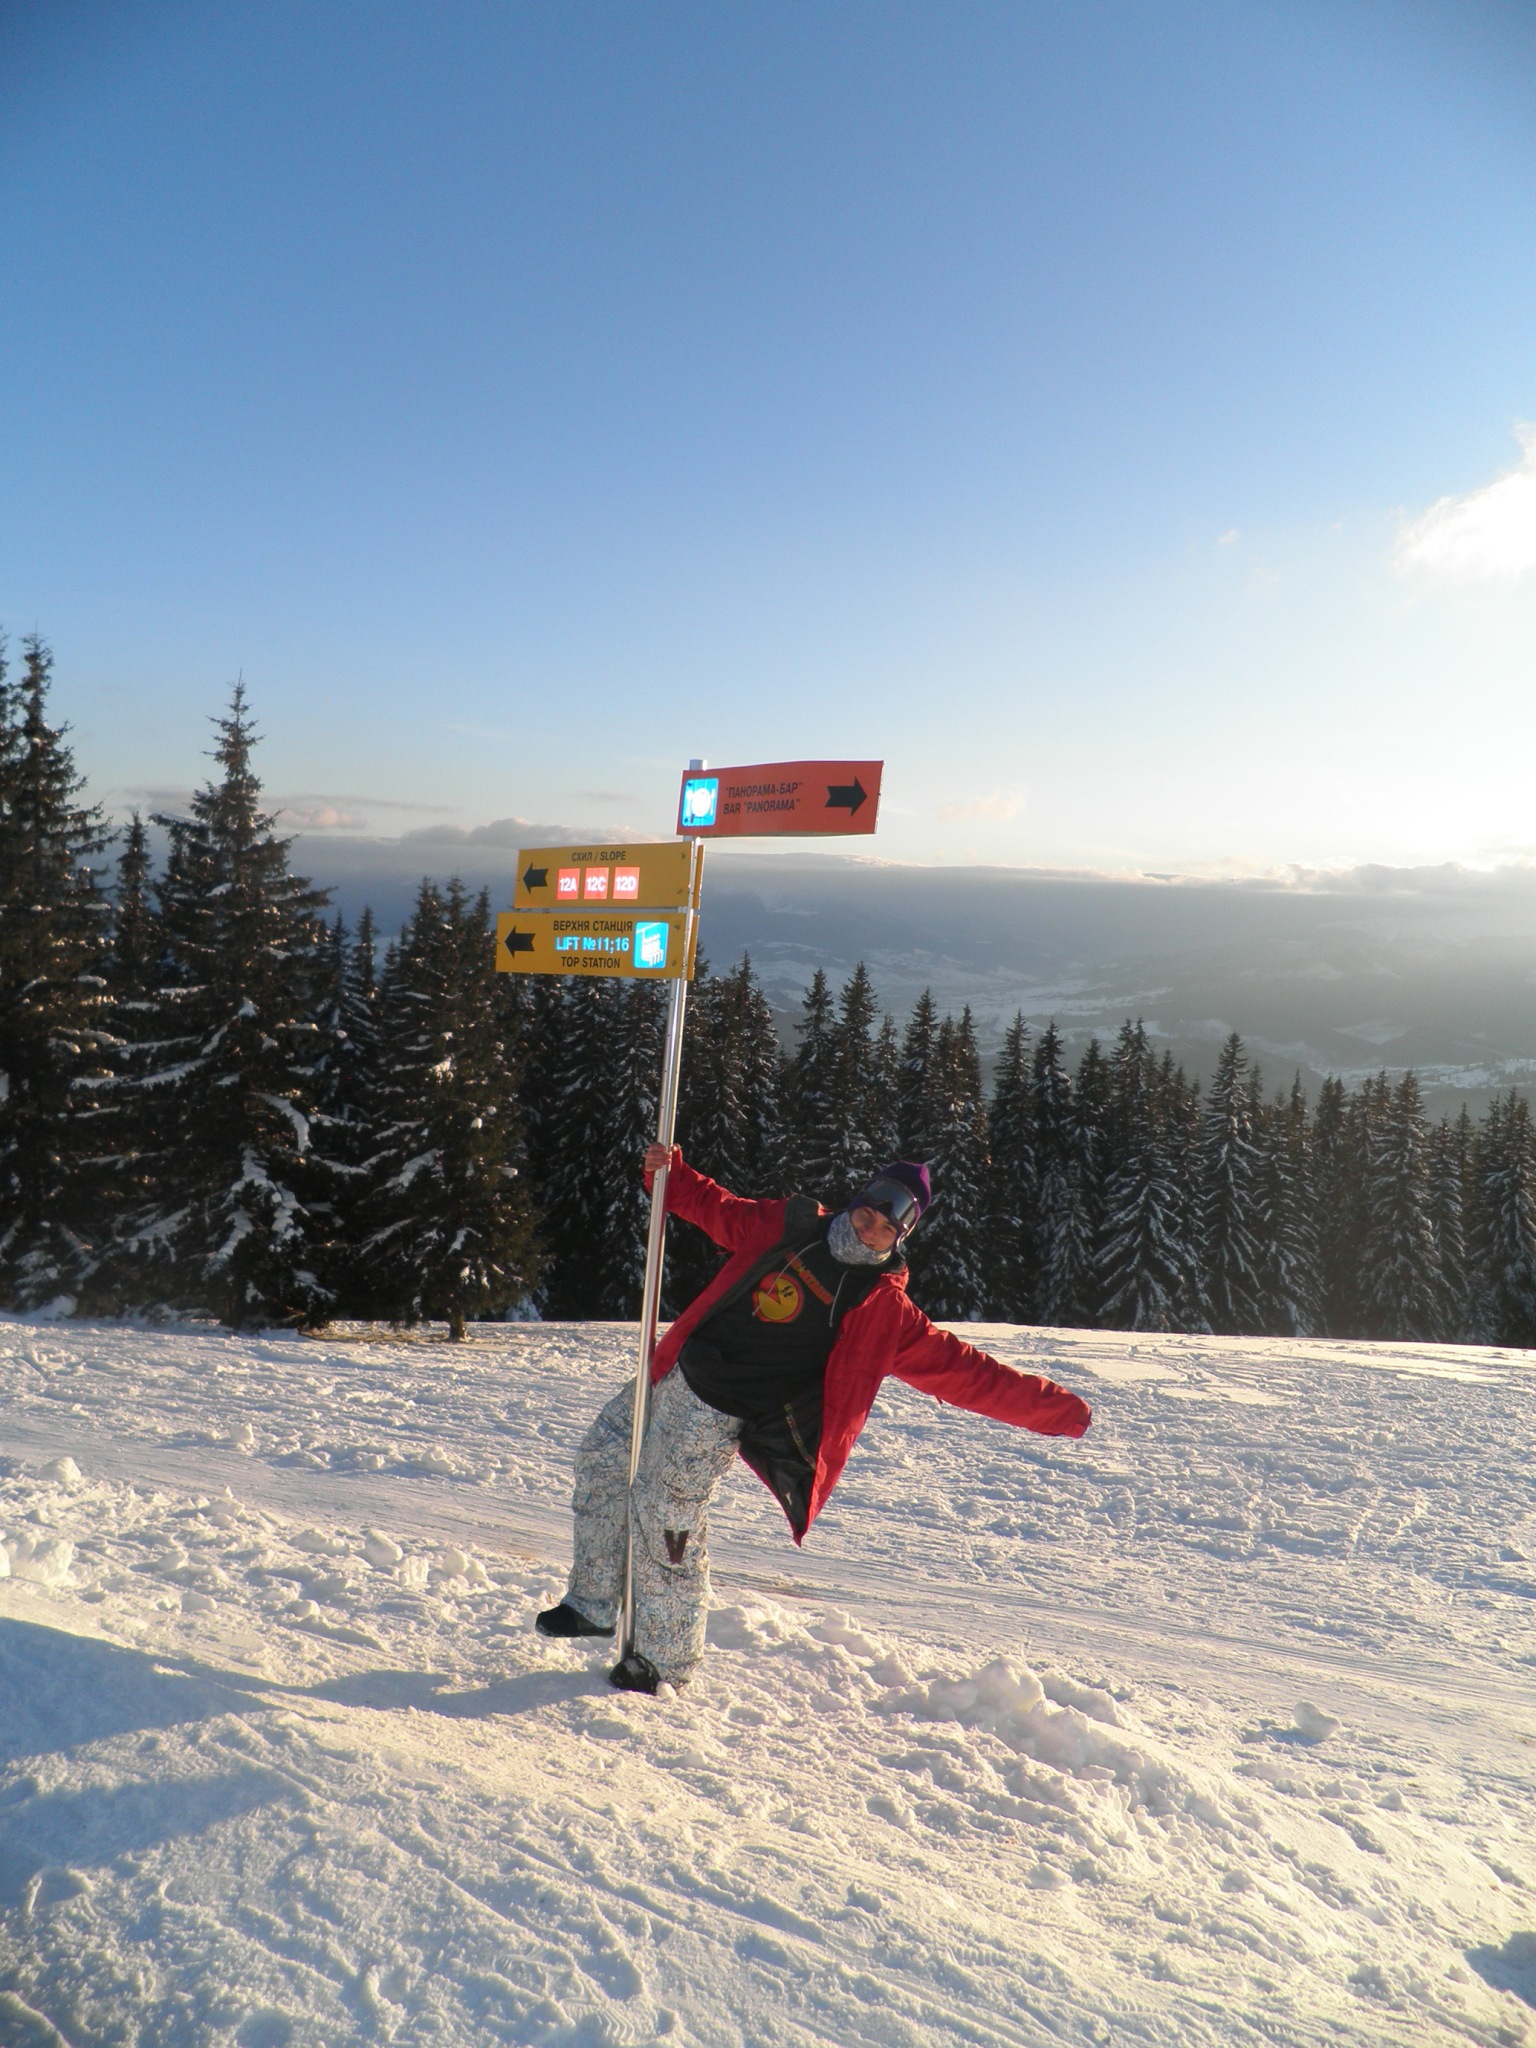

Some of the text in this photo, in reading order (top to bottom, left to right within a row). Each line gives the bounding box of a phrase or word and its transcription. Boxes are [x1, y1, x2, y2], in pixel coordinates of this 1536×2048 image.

[723, 799, 800, 815] BAR "PANORAMA"
[571, 852, 592, 861] СХИЛ
[600, 851, 626, 861] SLOPE
[560, 875, 637, 892] 12A 12C 12D
[553, 920, 633, 933] ВЕРХНЯ СТАНЦІЯ
[556, 936, 580, 951] LIFT
[561, 956, 621, 969] TOP STATION
